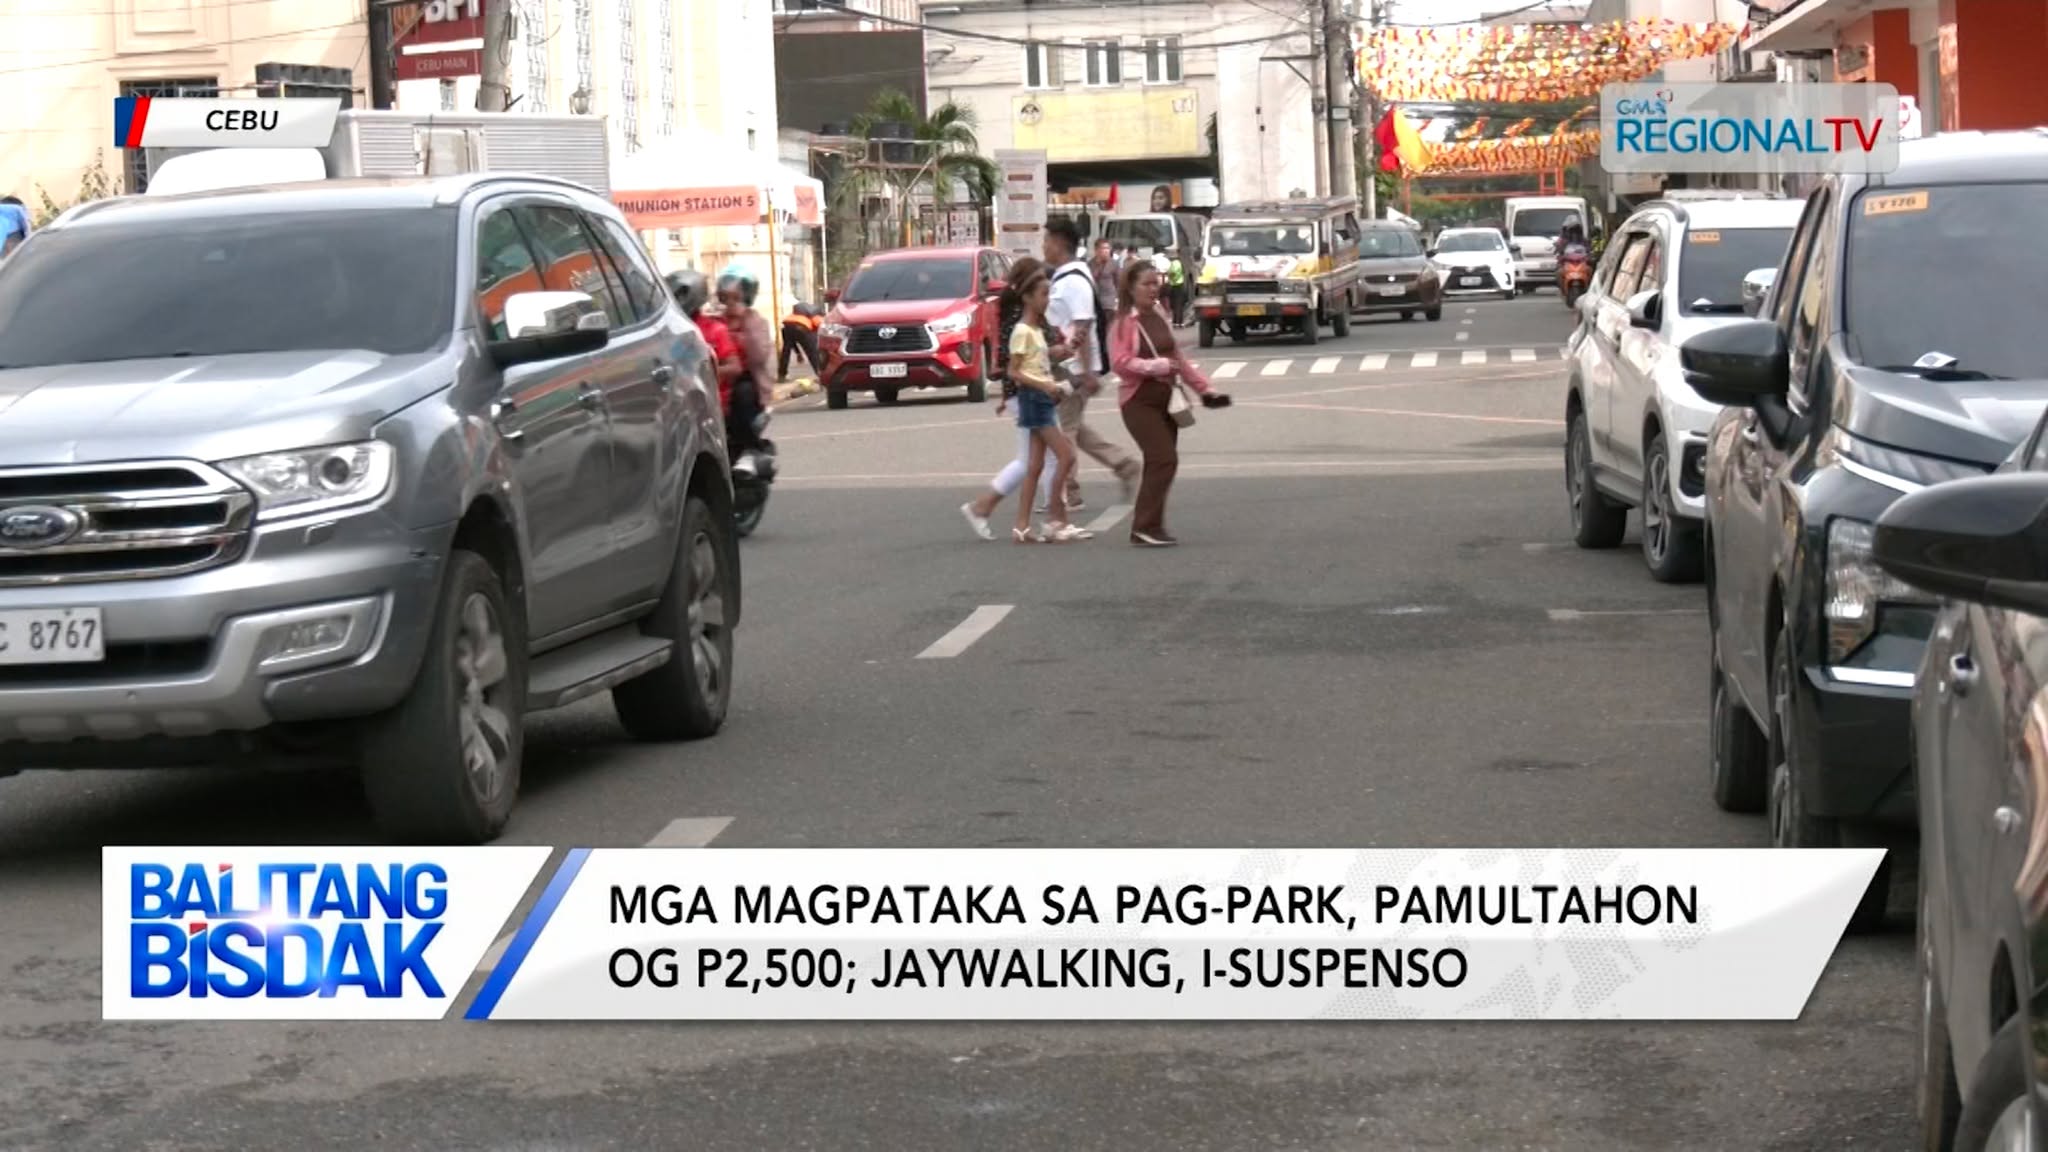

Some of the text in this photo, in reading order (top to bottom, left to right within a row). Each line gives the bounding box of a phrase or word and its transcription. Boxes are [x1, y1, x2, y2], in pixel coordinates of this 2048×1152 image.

[416, 57, 468, 72] CEBU MAIN
[684, 196, 742, 211] STATION
[746, 195, 755, 207] 5
[29, 619, 97, 651] 8767
